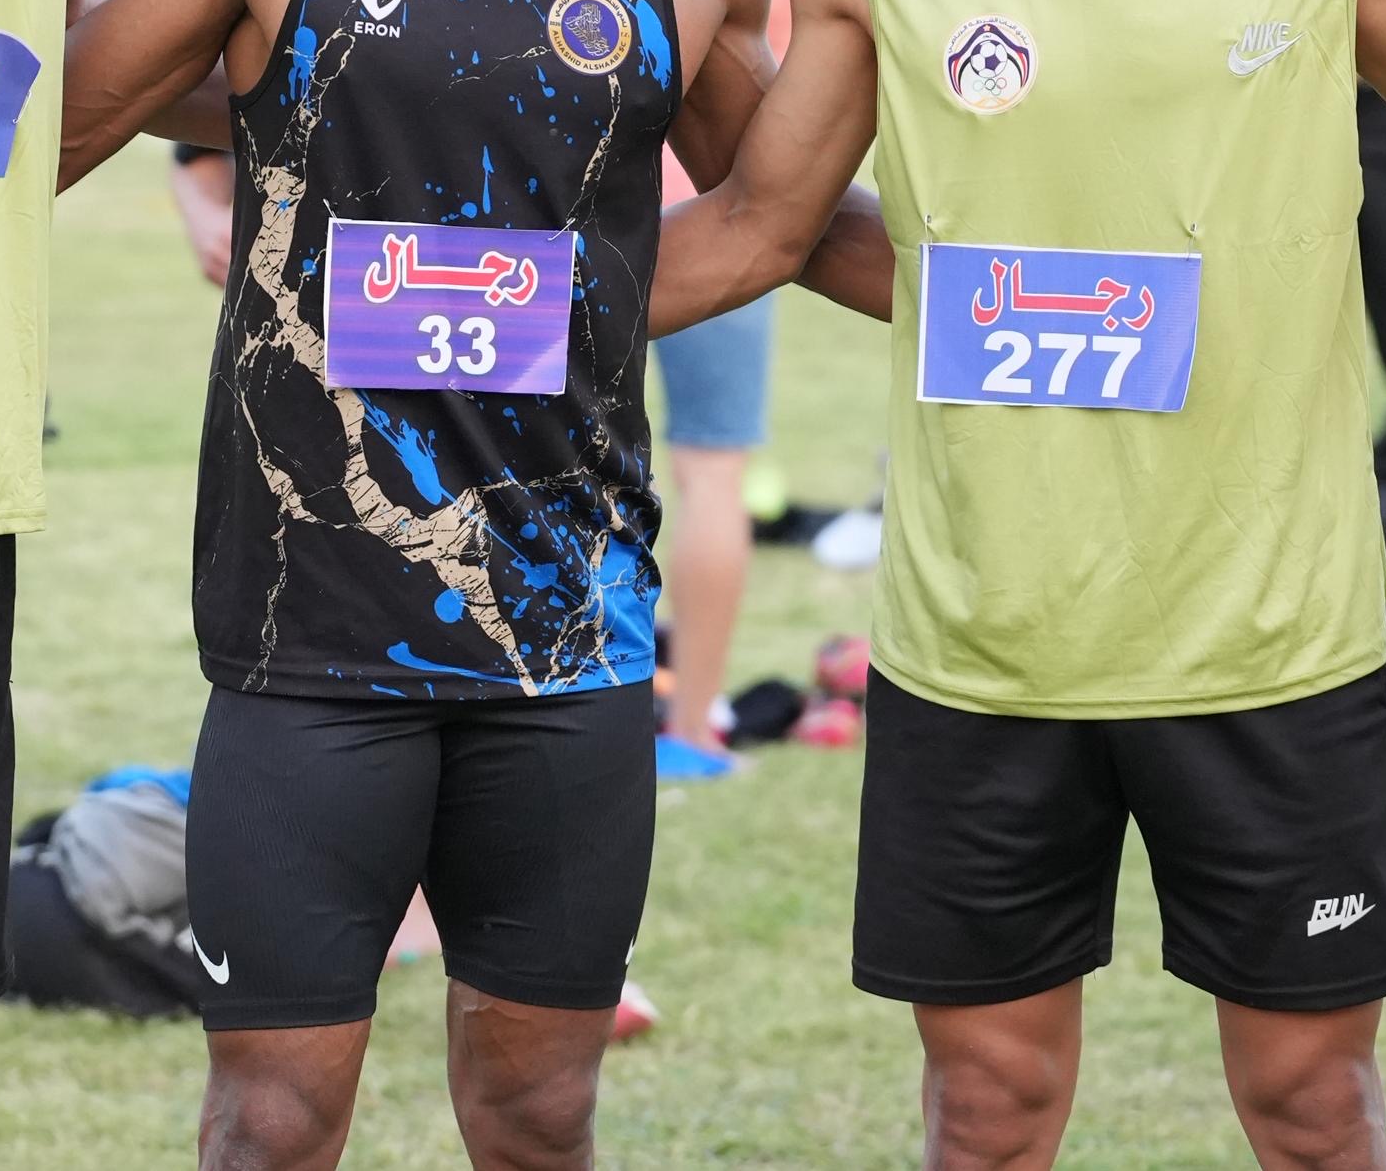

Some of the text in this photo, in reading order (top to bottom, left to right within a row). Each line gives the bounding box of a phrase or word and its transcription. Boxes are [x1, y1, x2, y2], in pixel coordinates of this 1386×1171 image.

[354, 20, 401, 39] ERON
[616, 12, 628, 28] نادي
[1240, 22, 1292, 52] NIKE
[553, 29, 627, 71] ALHASHID ALSHAABI SC
[363, 233, 539, 307] رجال
[971, 257, 1155, 332] رجال
[416, 314, 497, 376] 33
[981, 329, 1142, 399] 277
[1310, 892, 1365, 927] RUN
